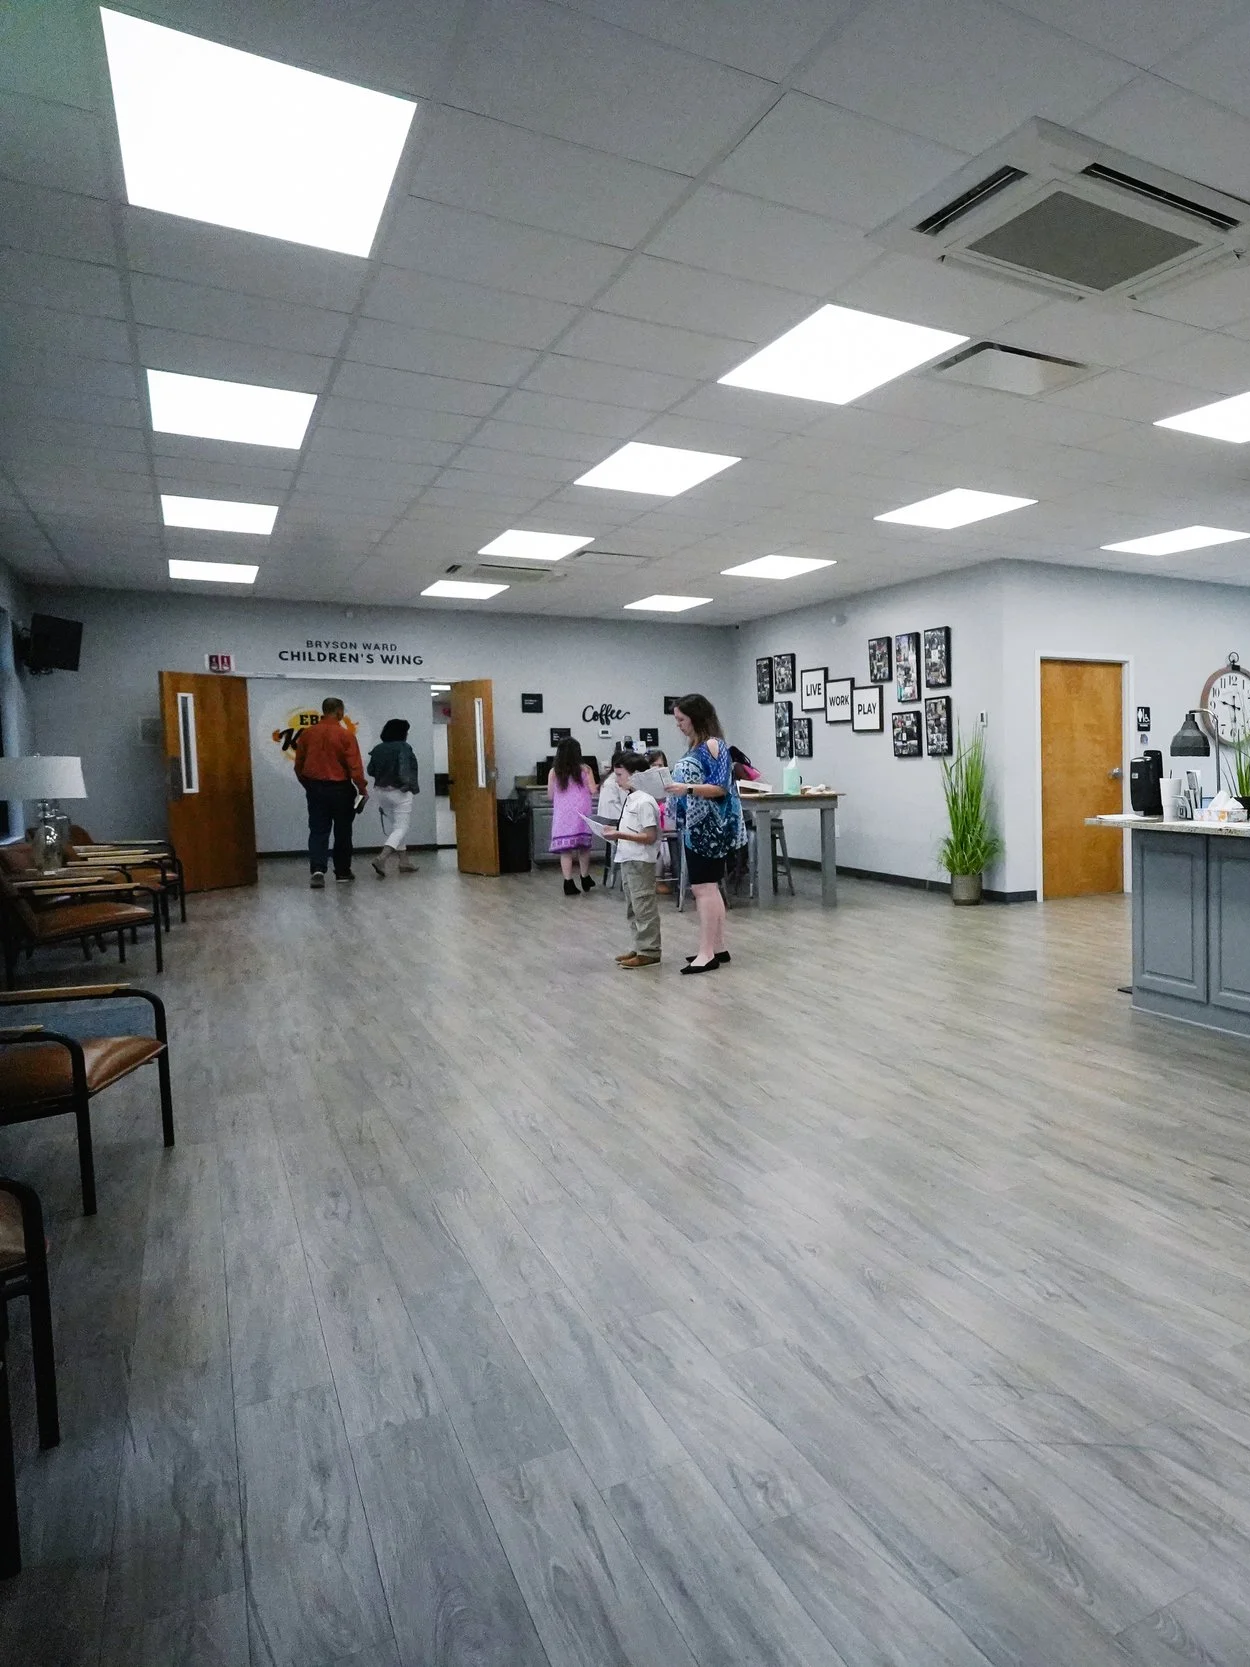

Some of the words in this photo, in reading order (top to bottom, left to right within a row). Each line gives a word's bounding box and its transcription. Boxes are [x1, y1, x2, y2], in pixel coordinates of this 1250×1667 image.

[306, 640, 357, 650] BRYSON
[362, 642, 398, 652] WARD
[278, 650, 375, 664] CHILDREN'S
[379, 654, 424, 666] WING
[1229, 675, 1238, 686] 12
[806, 682, 822, 697] LIVE
[1212, 687, 1220, 698] 10
[829, 694, 850, 707] WORK
[1210, 700, 1216, 710] 9
[582, 703, 631, 726] Coffee
[857, 702, 878, 716] PLAY
[299, 714, 324, 726] EB
